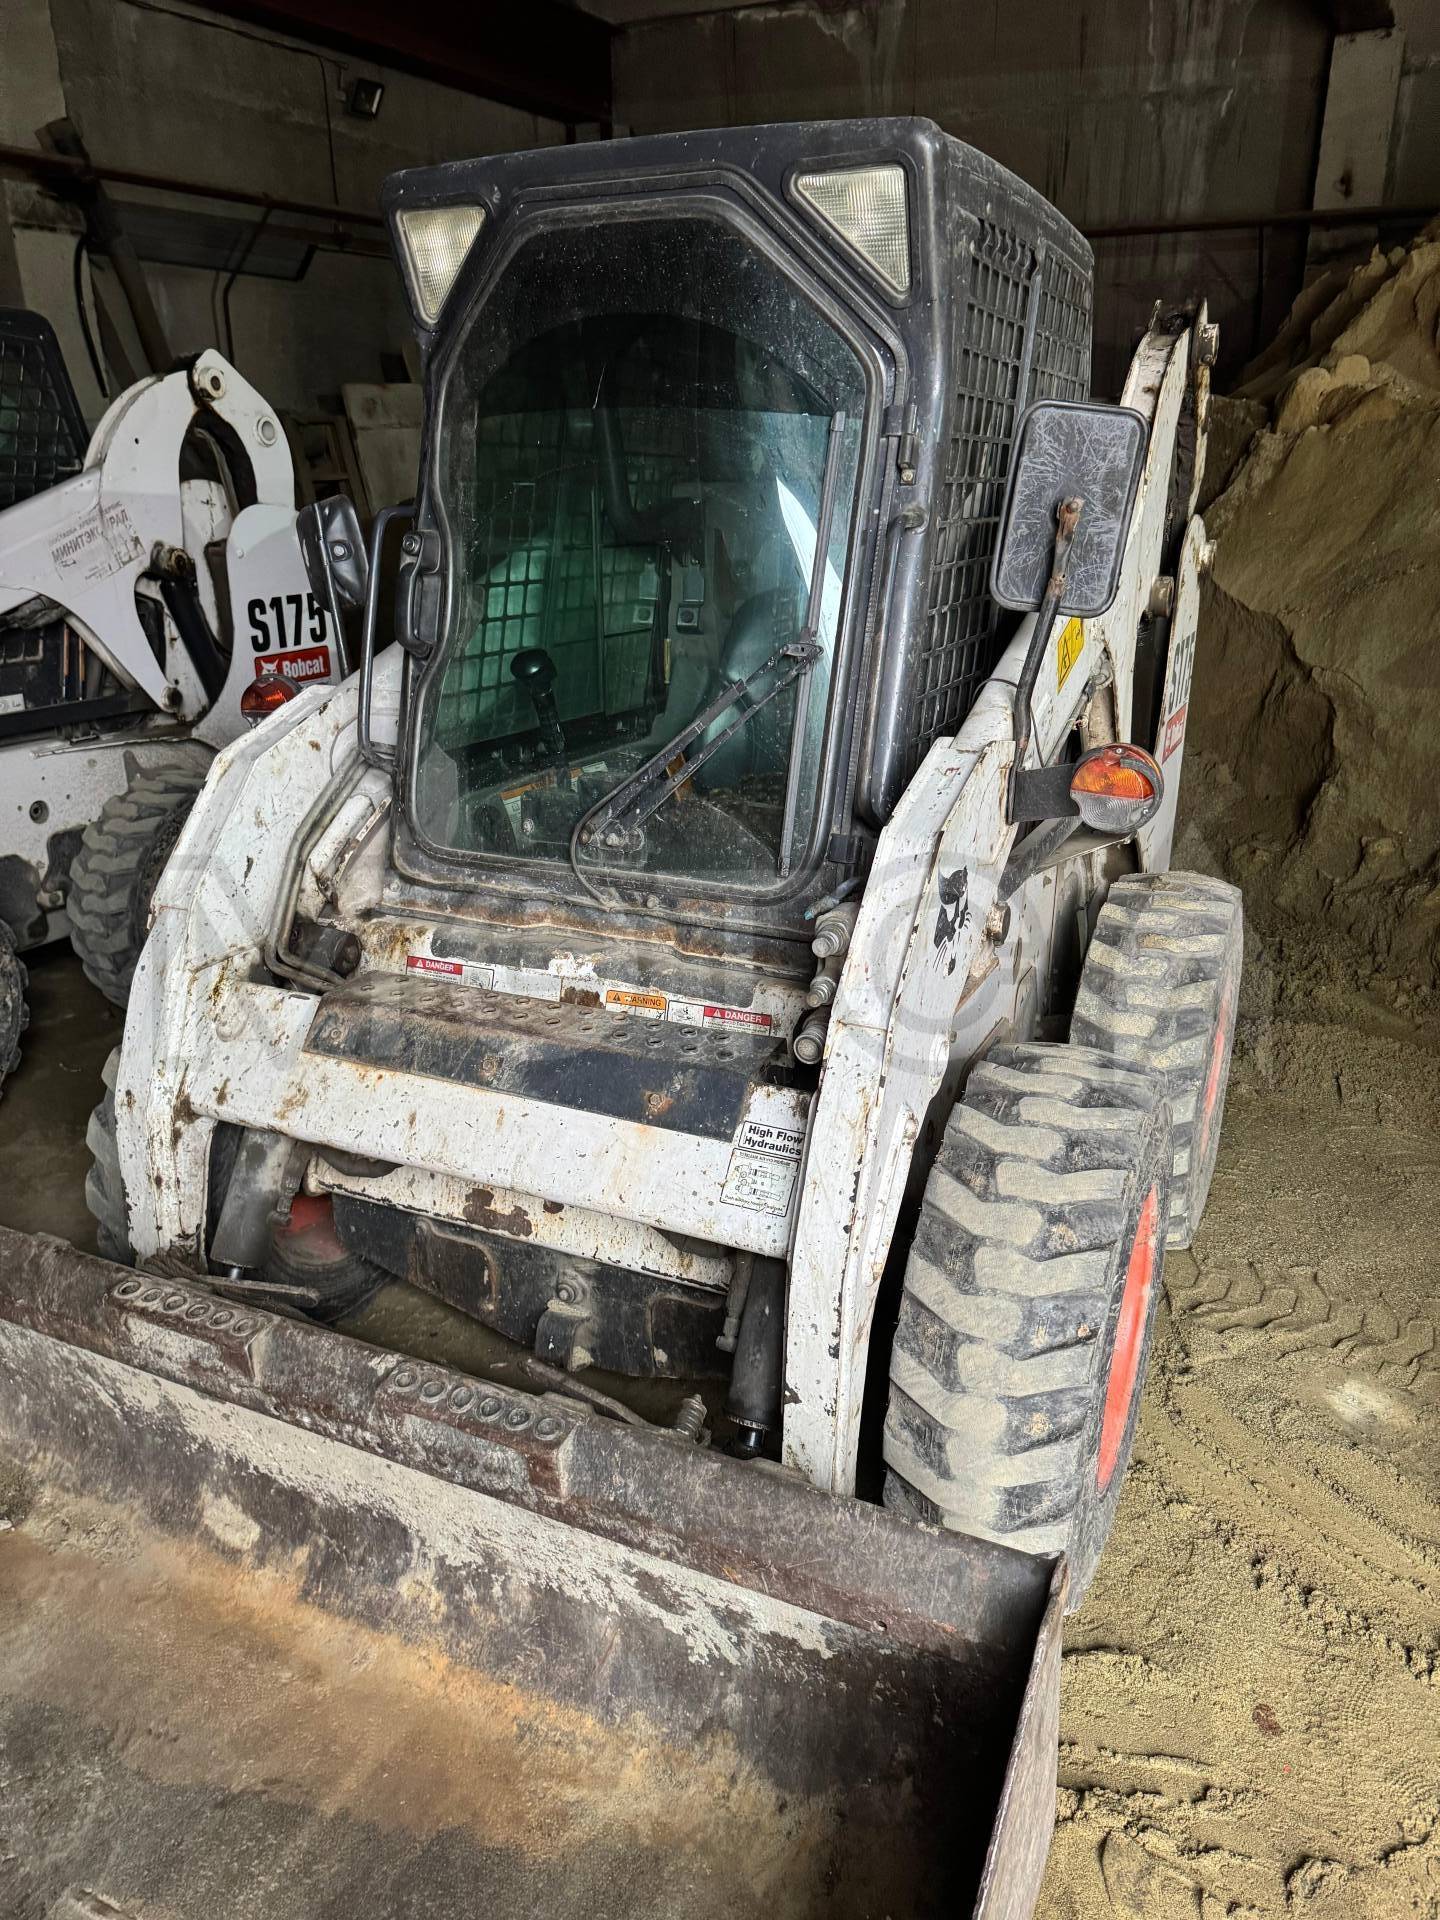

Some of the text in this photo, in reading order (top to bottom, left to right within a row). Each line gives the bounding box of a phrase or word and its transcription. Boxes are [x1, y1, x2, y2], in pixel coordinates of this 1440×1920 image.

[247, 592, 328, 653] S175
[282, 655, 325, 678] Bobcat
[425, 960, 455, 973] DANGER
[724, 1010, 763, 1024] DANGER
[748, 1124, 803, 1145] High Flow
[743, 1135, 802, 1156] Hydraulics
